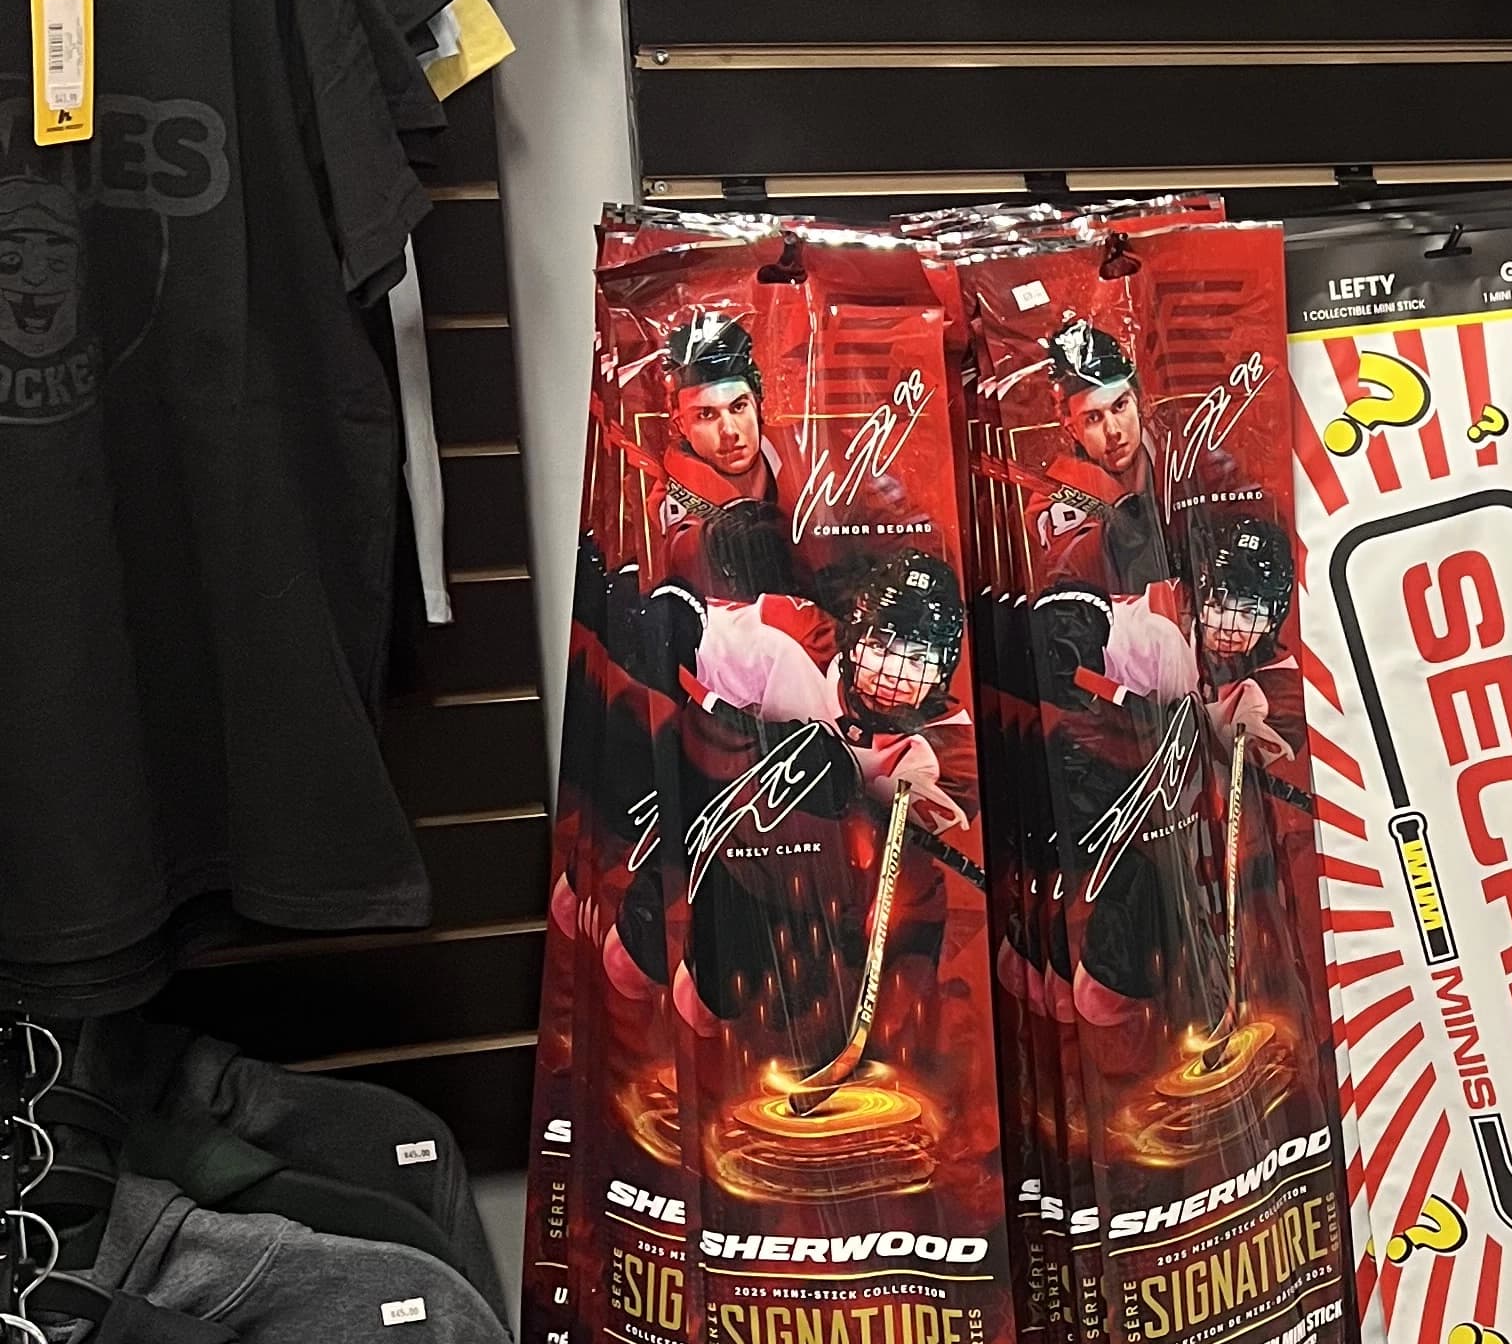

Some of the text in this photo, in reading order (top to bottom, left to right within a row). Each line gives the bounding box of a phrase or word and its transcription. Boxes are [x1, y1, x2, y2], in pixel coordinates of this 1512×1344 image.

[1328, 274, 1396, 302] LEFTY
[1310, 304, 1372, 320] COLLECTIBLE
[1373, 303, 1396, 316] MINI
[1397, 300, 1426, 313] STICK
[813, 523, 933, 536] CONNOR BEDARD
[1237, 534, 1261, 550] 26
[905, 571, 930, 589] 26
[726, 843, 822, 858] EMILY CLARK
[1430, 966, 1496, 1109] MINIS
[1107, 1125, 1332, 1242] SHERWOOD
[699, 1229, 989, 1265] SHERWOOD
[1124, 1280, 1141, 1343] SÉRIE
[1141, 1196, 1330, 1339] SIGNATURE
[733, 1283, 946, 1301] 2025 MINI-STICK COLLECTION
